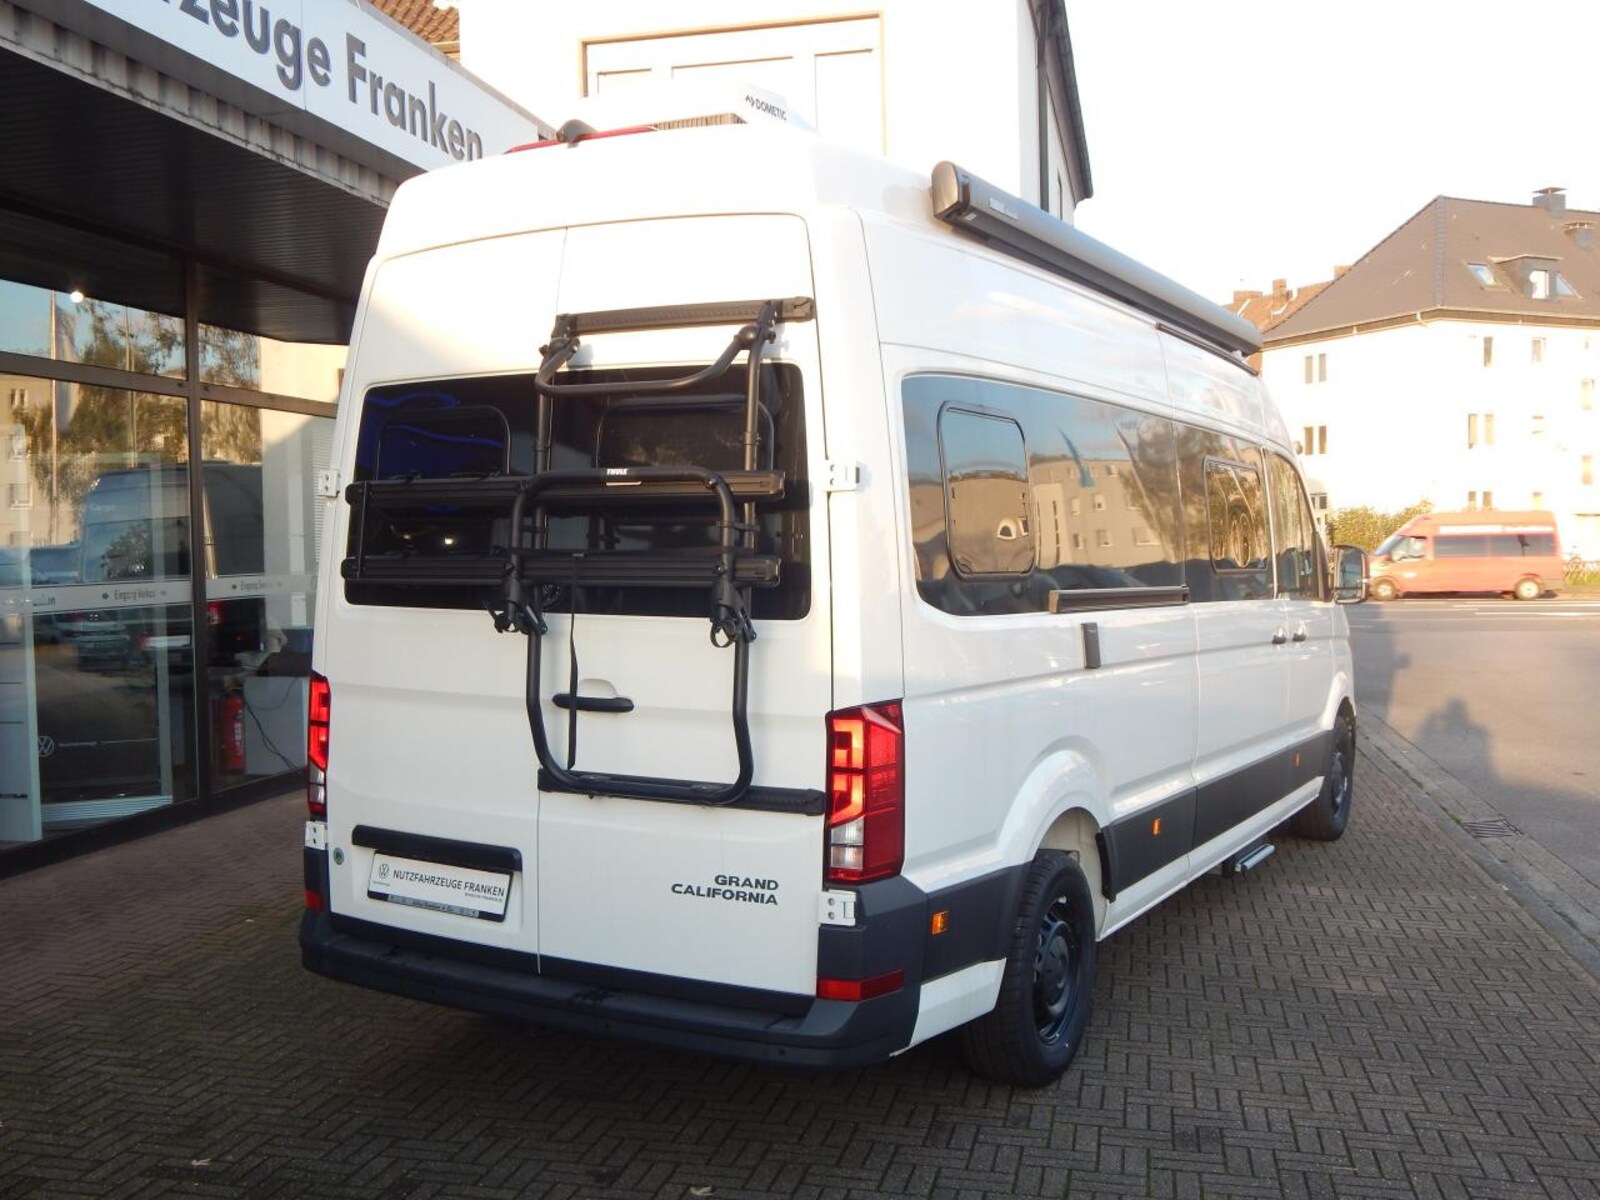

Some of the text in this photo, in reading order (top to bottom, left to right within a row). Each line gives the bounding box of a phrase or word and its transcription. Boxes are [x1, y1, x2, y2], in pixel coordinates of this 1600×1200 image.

[345, 31, 483, 162] Franken
[755, 98, 787, 121] DOMETIC
[393, 869, 462, 890] NUTZFAHRZEUGE
[464, 881, 505, 898] FRANKEN
[714, 874, 779, 891] GRAND
[671, 883, 778, 906] CALIFORNIA
